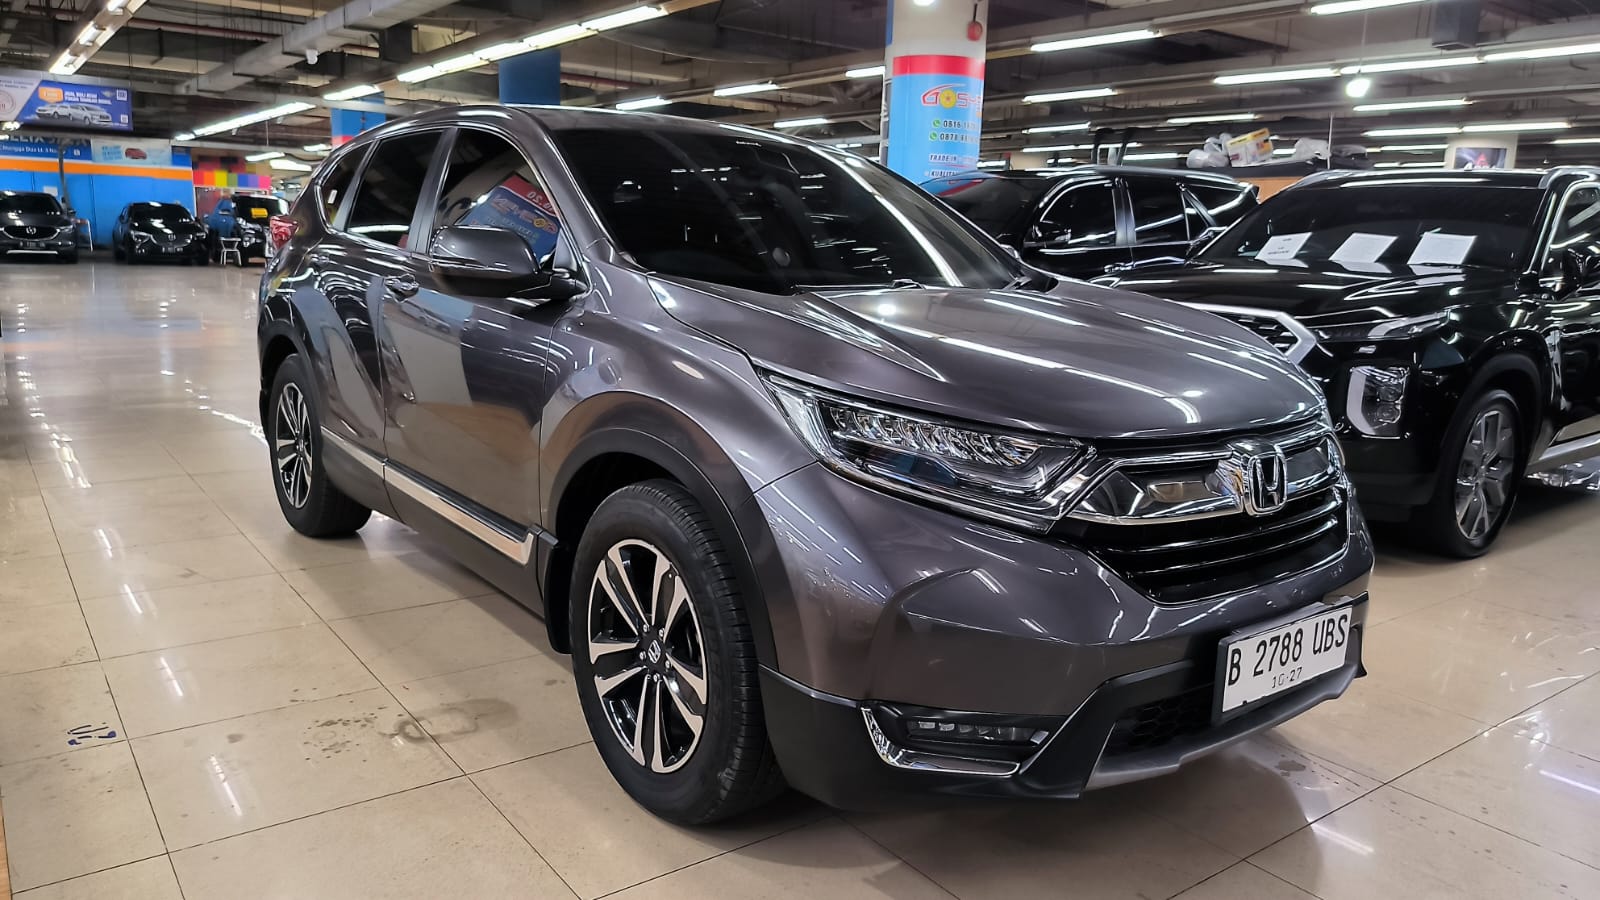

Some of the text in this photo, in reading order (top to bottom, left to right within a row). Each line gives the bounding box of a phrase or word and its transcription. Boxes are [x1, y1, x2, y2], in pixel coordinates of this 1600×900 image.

[1227, 614, 1348, 686] B 2788 UBS
